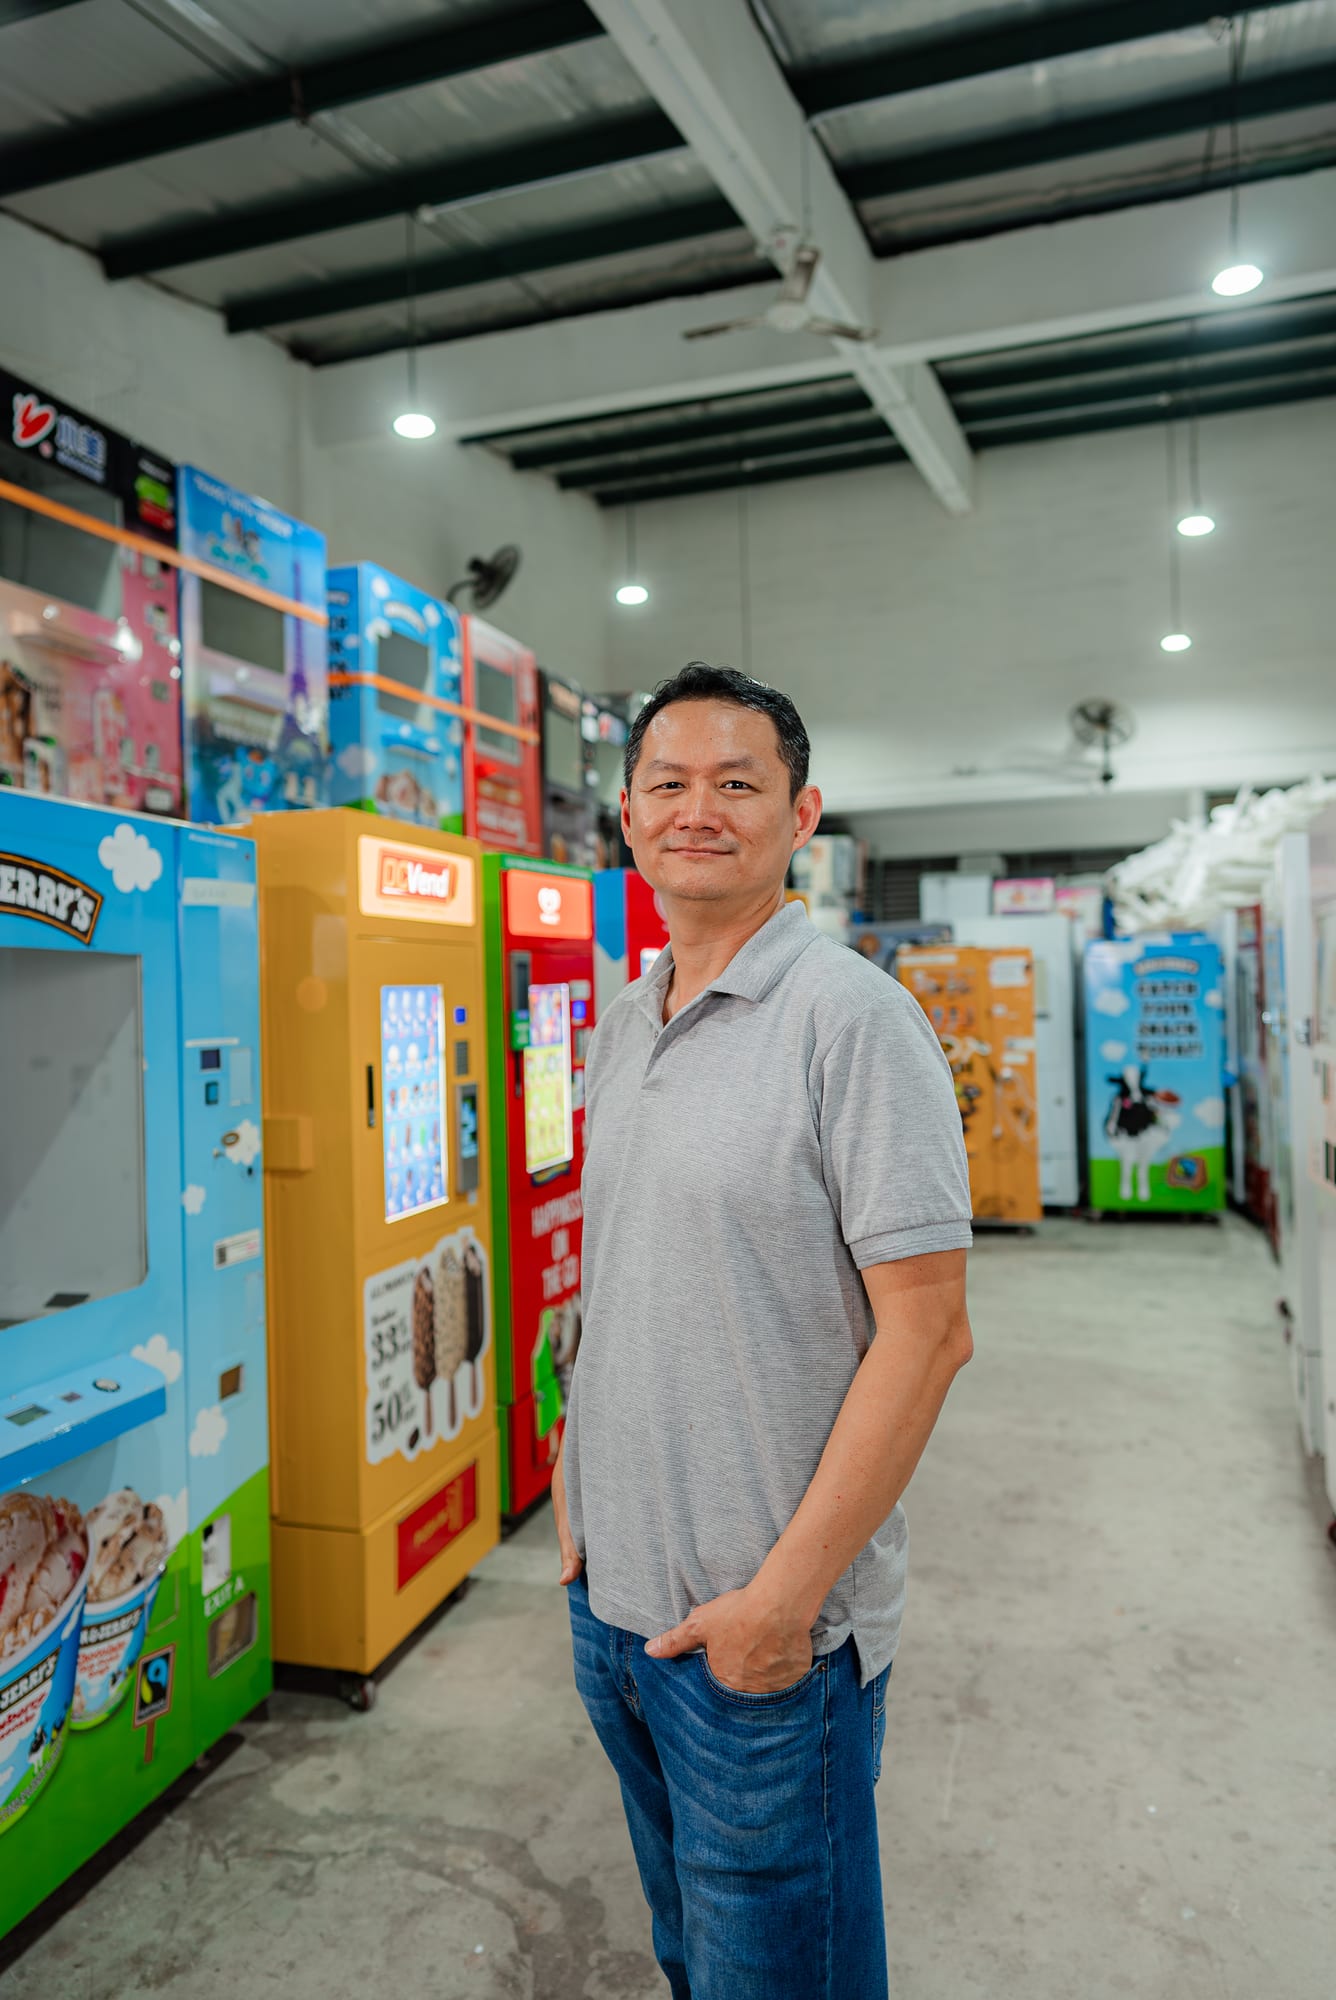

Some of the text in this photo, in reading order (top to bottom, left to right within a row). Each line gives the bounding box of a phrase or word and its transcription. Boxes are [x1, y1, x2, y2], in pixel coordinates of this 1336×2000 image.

[551, 1227, 570, 1262] ON
[541, 1253, 580, 1300] THE GO
[204, 1575, 245, 1618] EXIT A
